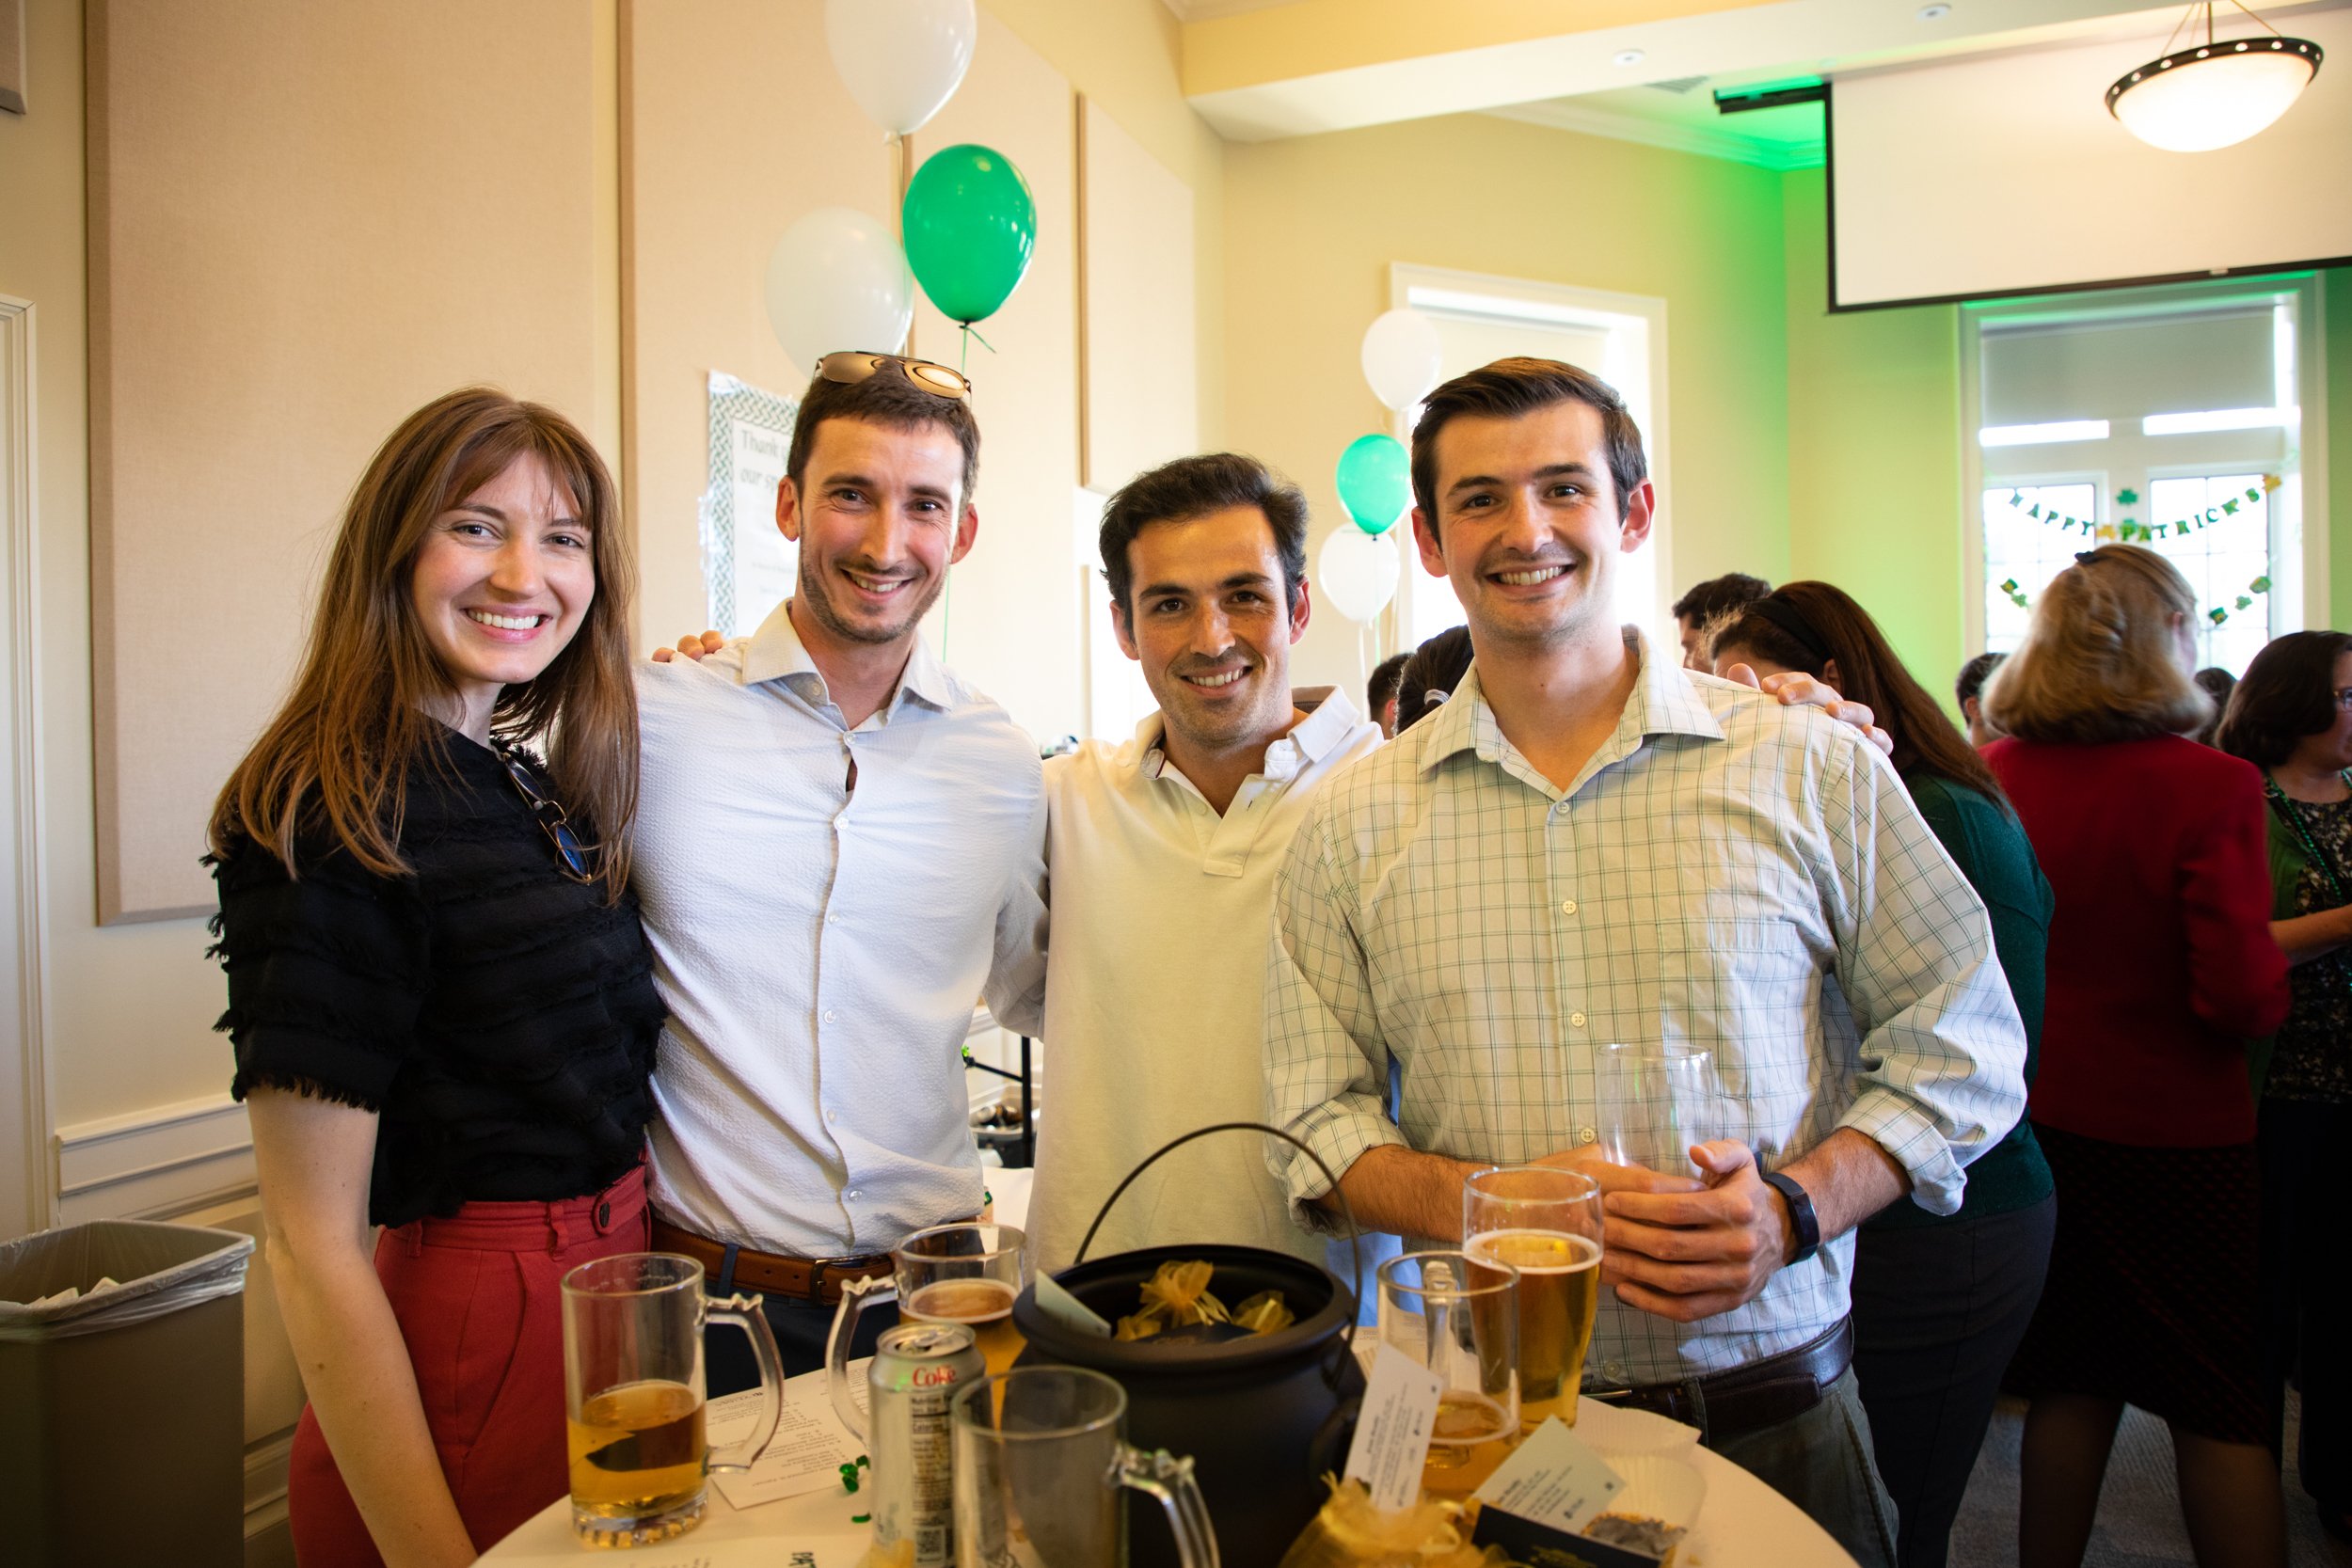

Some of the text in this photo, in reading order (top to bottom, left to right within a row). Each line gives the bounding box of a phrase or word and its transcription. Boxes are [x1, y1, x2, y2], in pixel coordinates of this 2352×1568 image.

[741, 430, 778, 457] Thank
[740, 467, 762, 484] our
[2010, 493, 2097, 536] HAPPY
[913, 1367, 957, 1387] Coke
